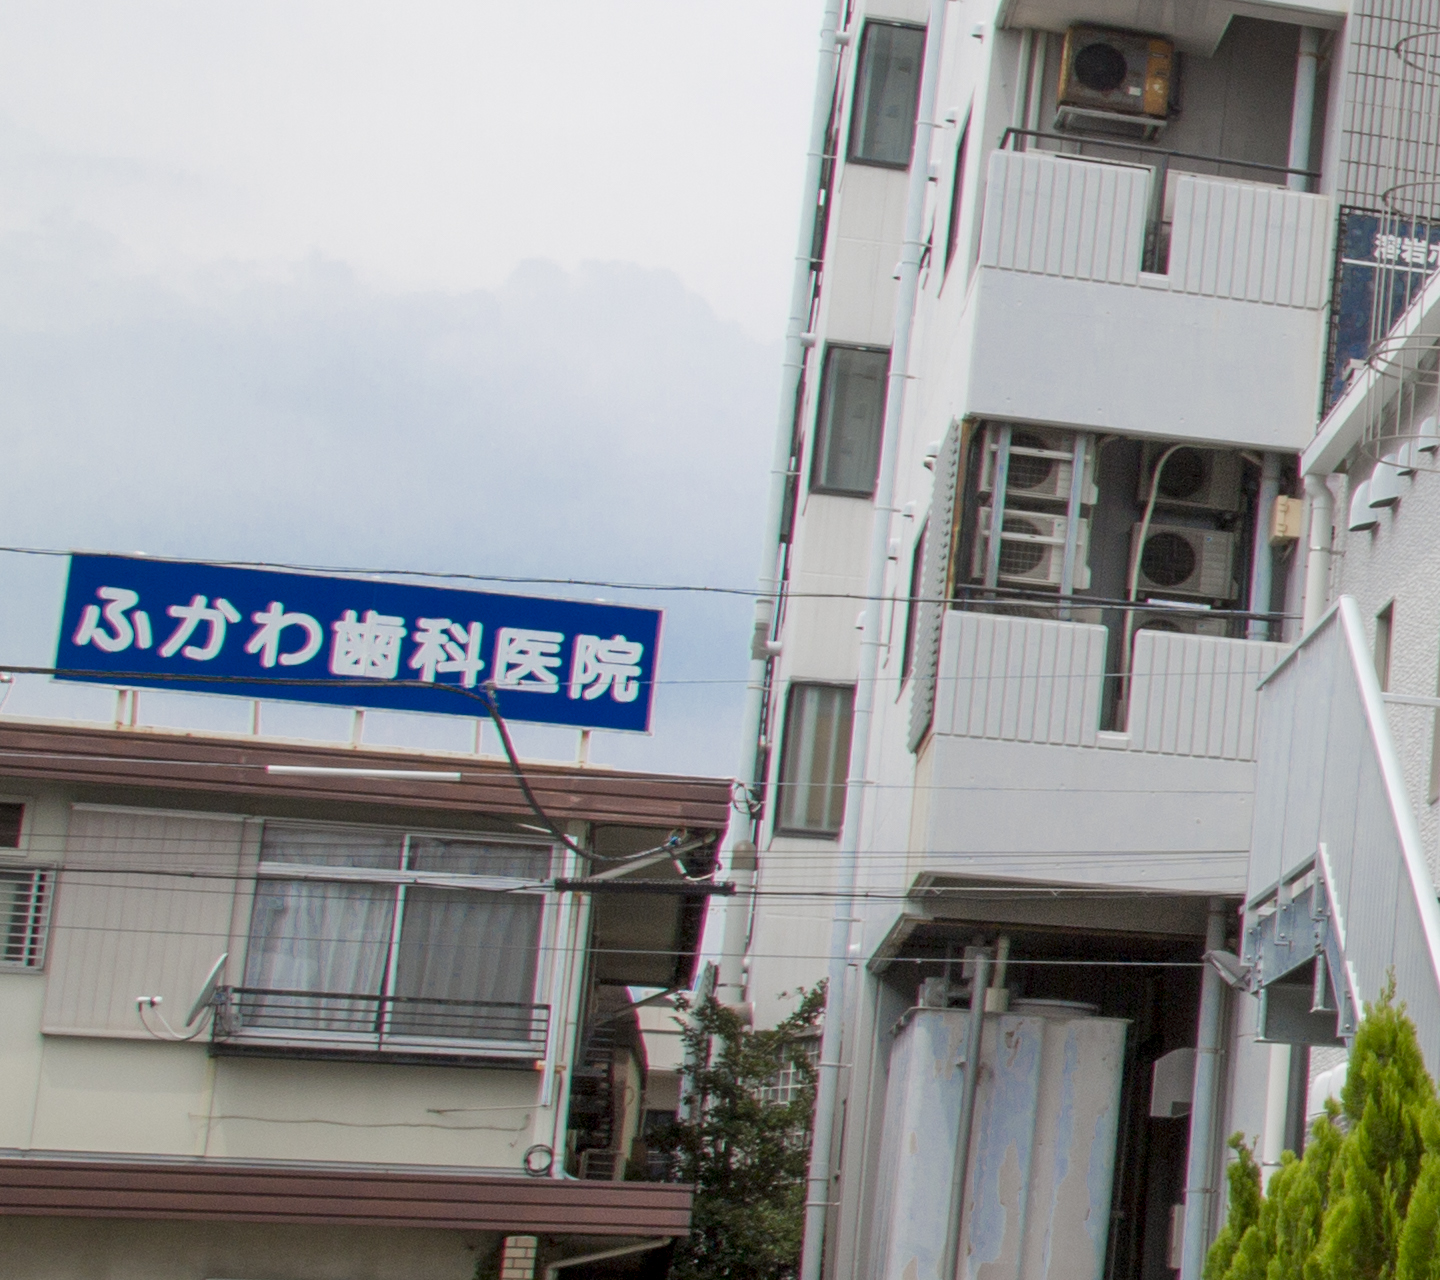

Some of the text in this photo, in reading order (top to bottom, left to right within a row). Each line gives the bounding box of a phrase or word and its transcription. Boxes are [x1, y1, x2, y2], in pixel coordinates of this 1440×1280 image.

[72, 586, 645, 703] ふかわ歯科医院
